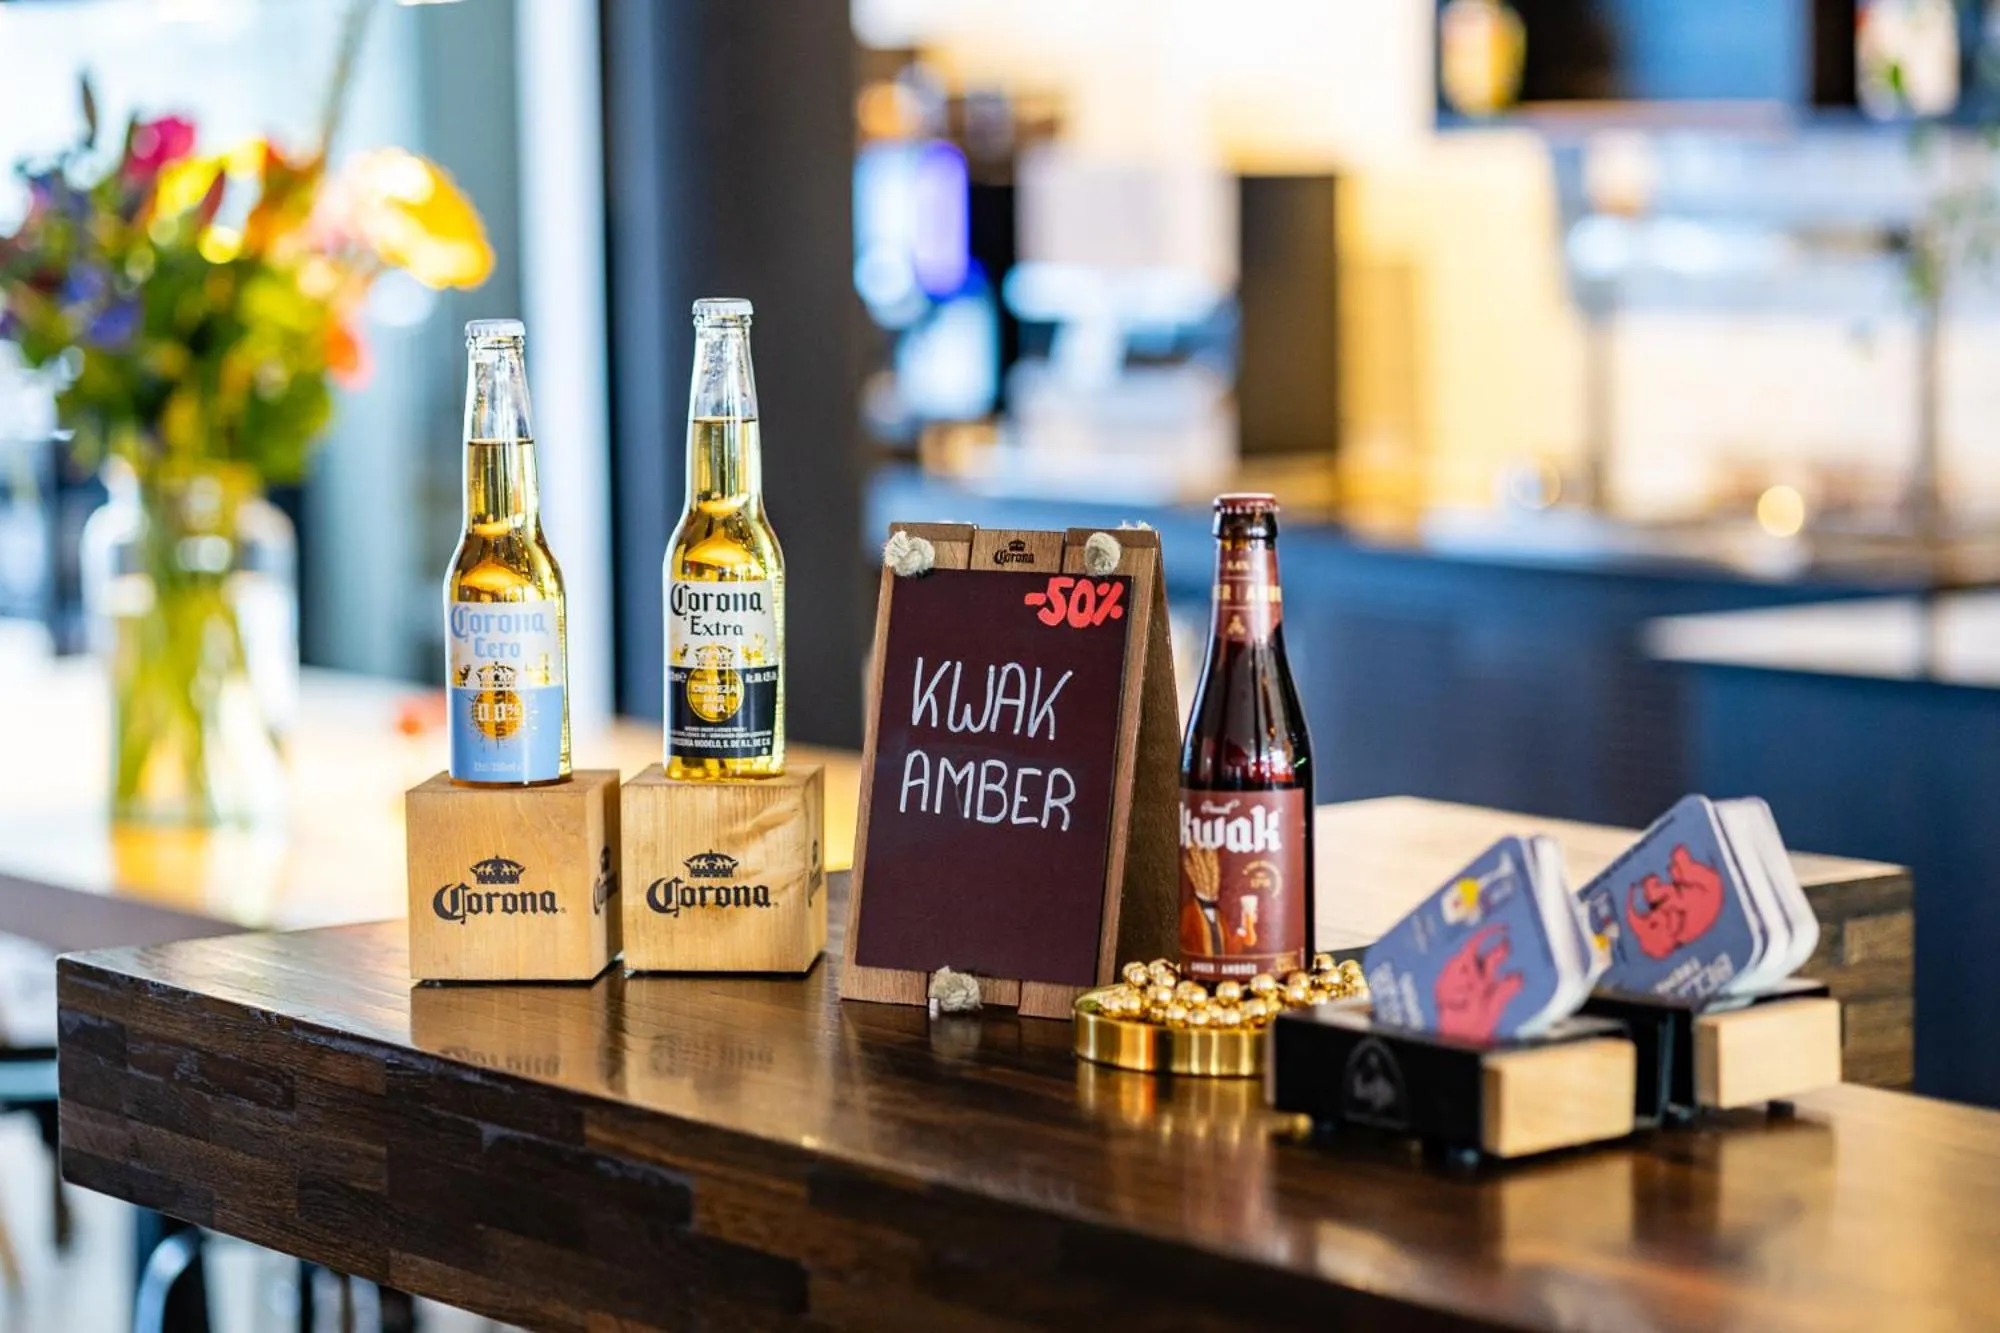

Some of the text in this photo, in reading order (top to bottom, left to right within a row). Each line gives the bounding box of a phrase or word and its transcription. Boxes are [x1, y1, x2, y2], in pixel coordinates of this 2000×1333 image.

[993, 549, 1035, 566] Corona
[671, 583, 764, 620] Corona
[1024, 577, 1124, 628] -50%
[451, 605, 548, 642] Corona
[690, 615, 744, 636] Extra
[474, 637, 522, 658] Cero
[911, 657, 1074, 741] KWAK
[899, 749, 1077, 832] AMBER
[1179, 802, 1282, 853] kwak
[432, 882, 559, 925] Corona
[646, 876, 772, 918] Corona
